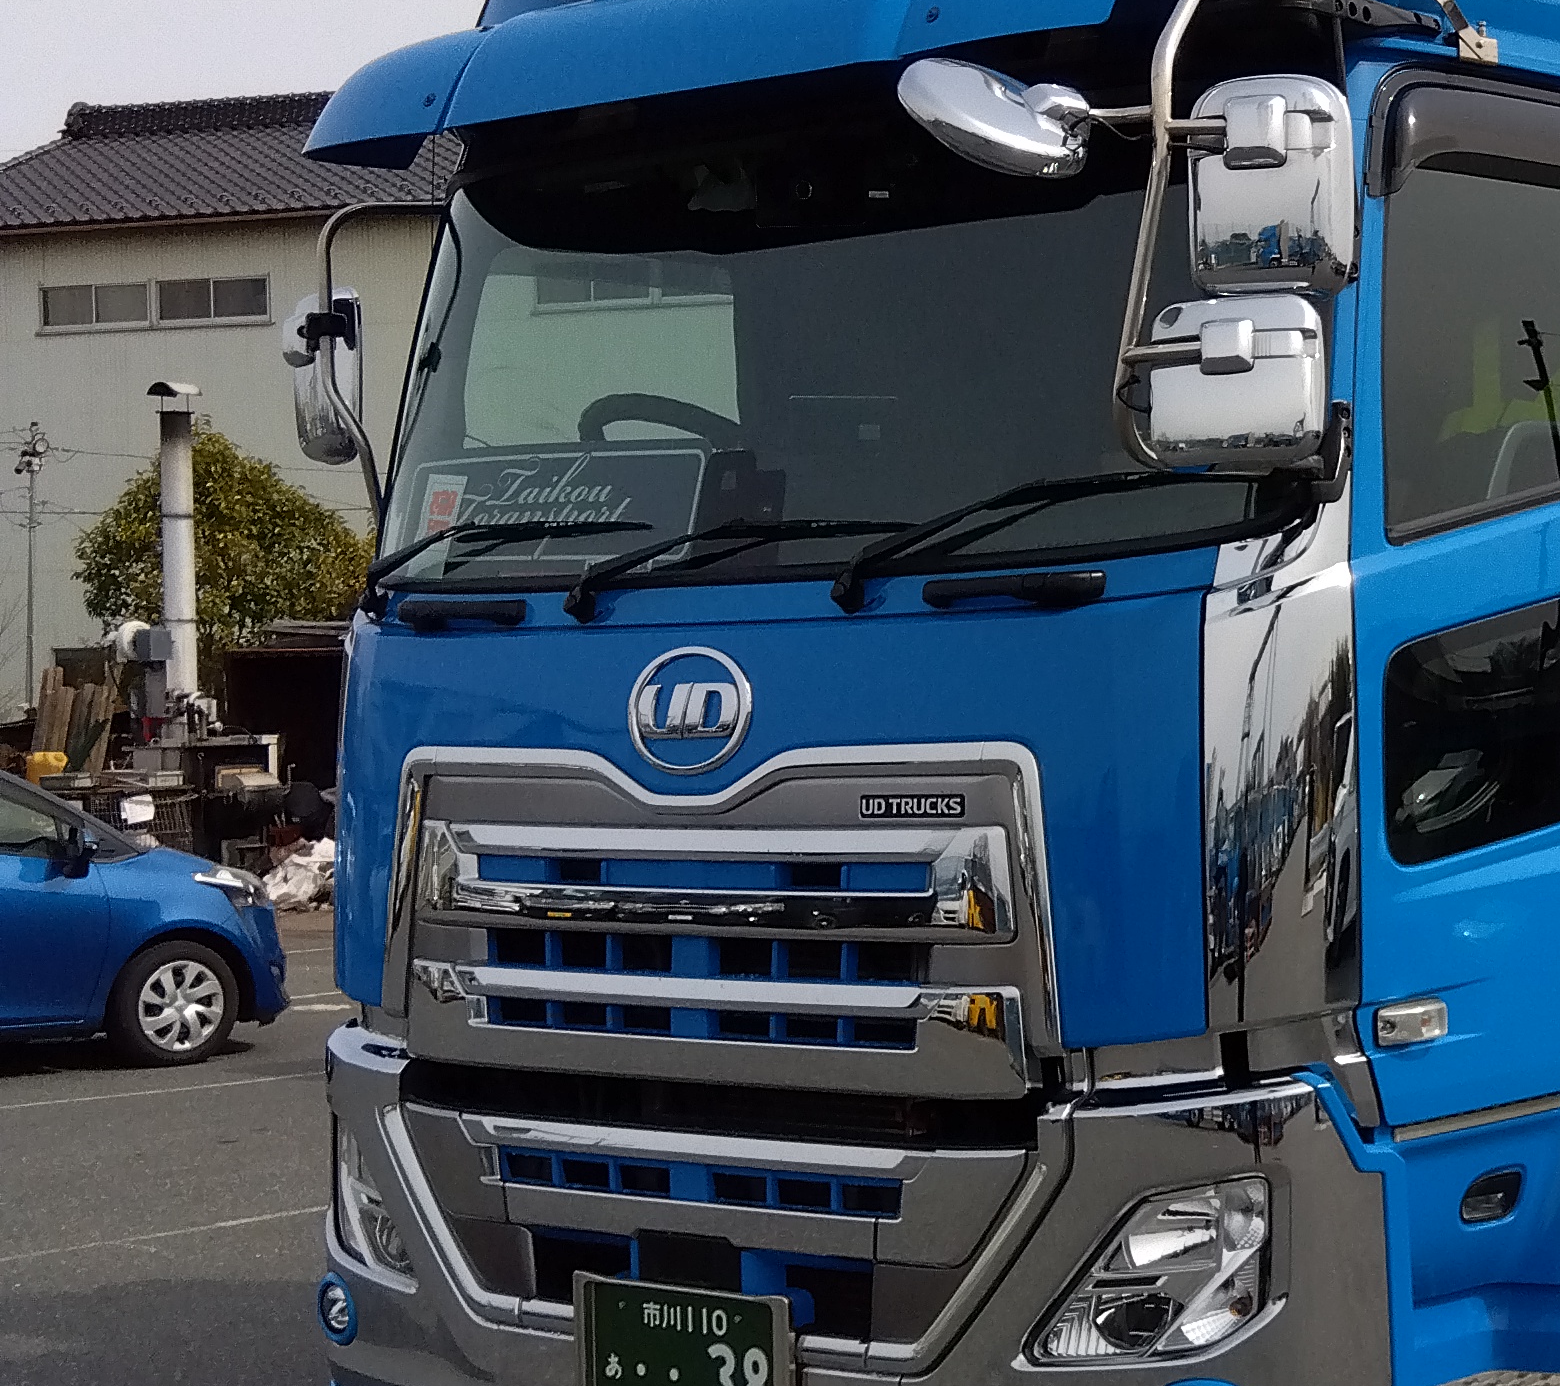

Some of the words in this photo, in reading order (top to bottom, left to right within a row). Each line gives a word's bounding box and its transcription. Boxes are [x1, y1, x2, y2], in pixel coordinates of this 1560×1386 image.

[486, 452, 614, 506] Taikou
[637, 682, 741, 740] UD
[861, 800, 886, 815] UD
[888, 798, 962, 815] TRUCKS
[604, 1352, 623, 1380] あ
